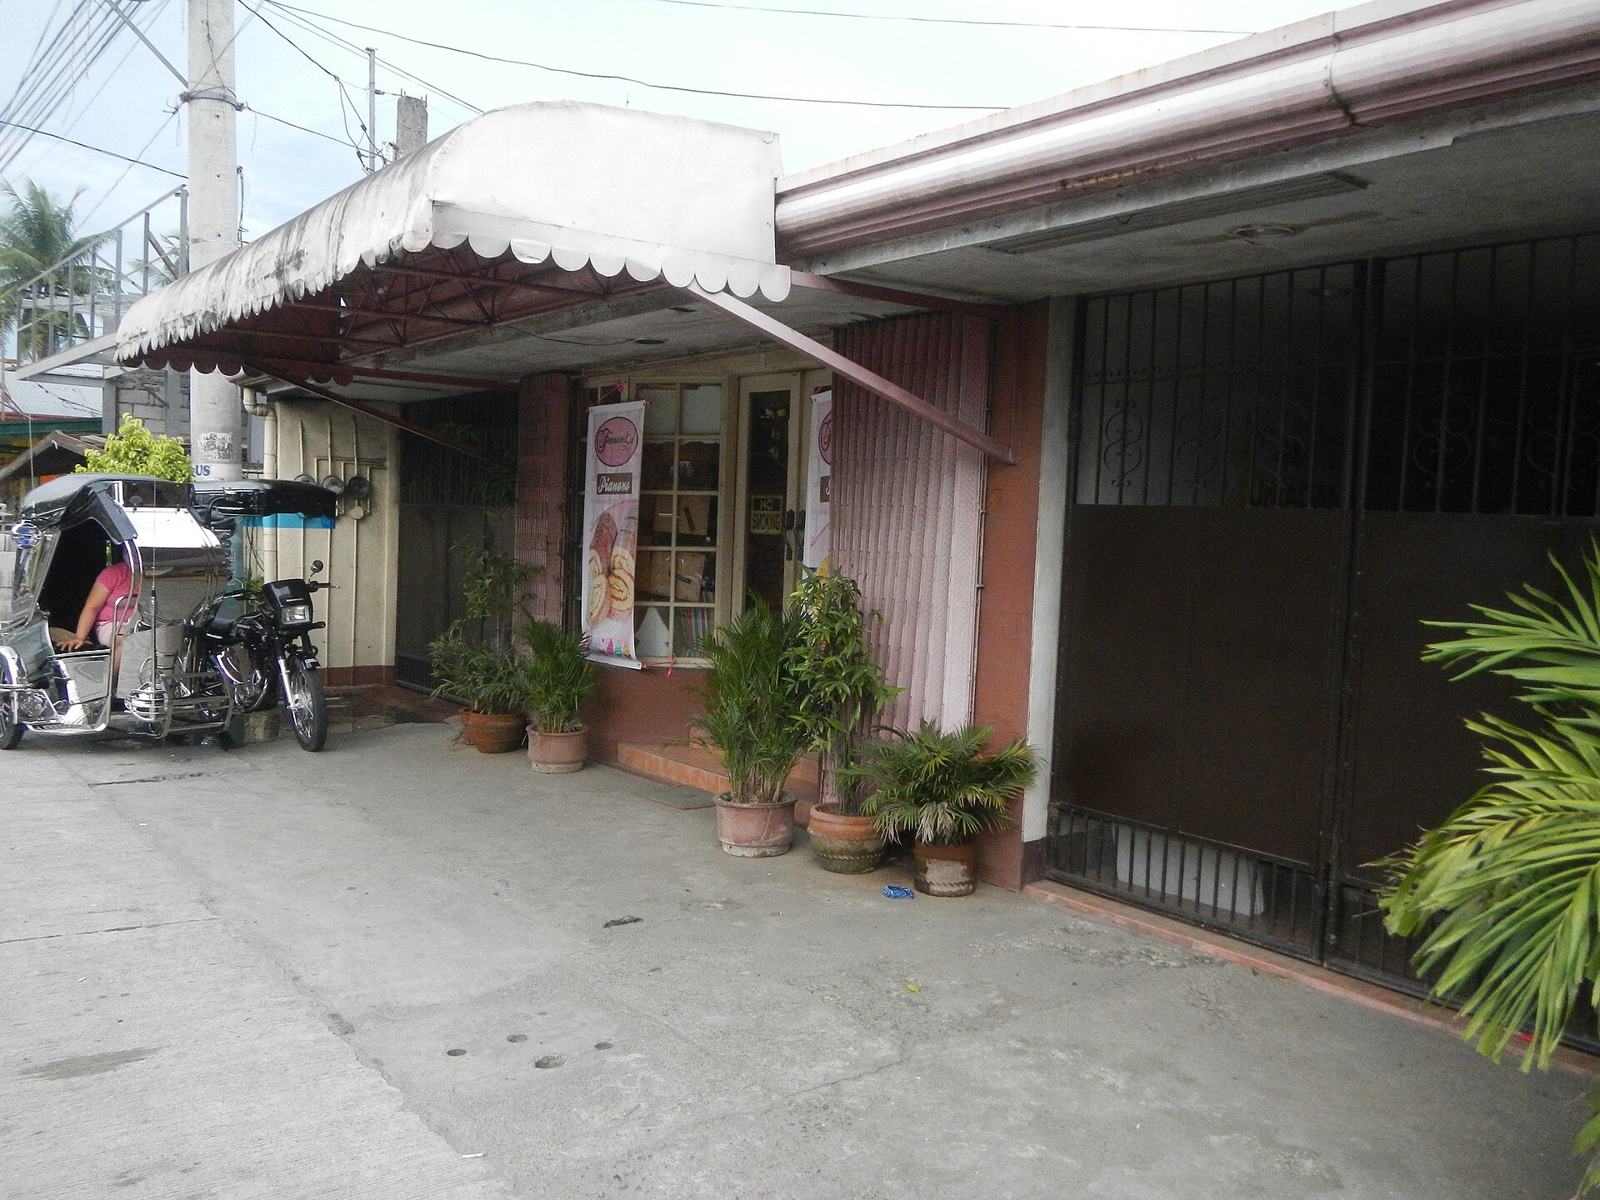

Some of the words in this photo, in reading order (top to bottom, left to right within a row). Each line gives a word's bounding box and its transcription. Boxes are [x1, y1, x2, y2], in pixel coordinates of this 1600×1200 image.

[598, 475, 631, 493] Pianono
[760, 499, 774, 510] NO
[752, 512, 782, 530] SMOKING
